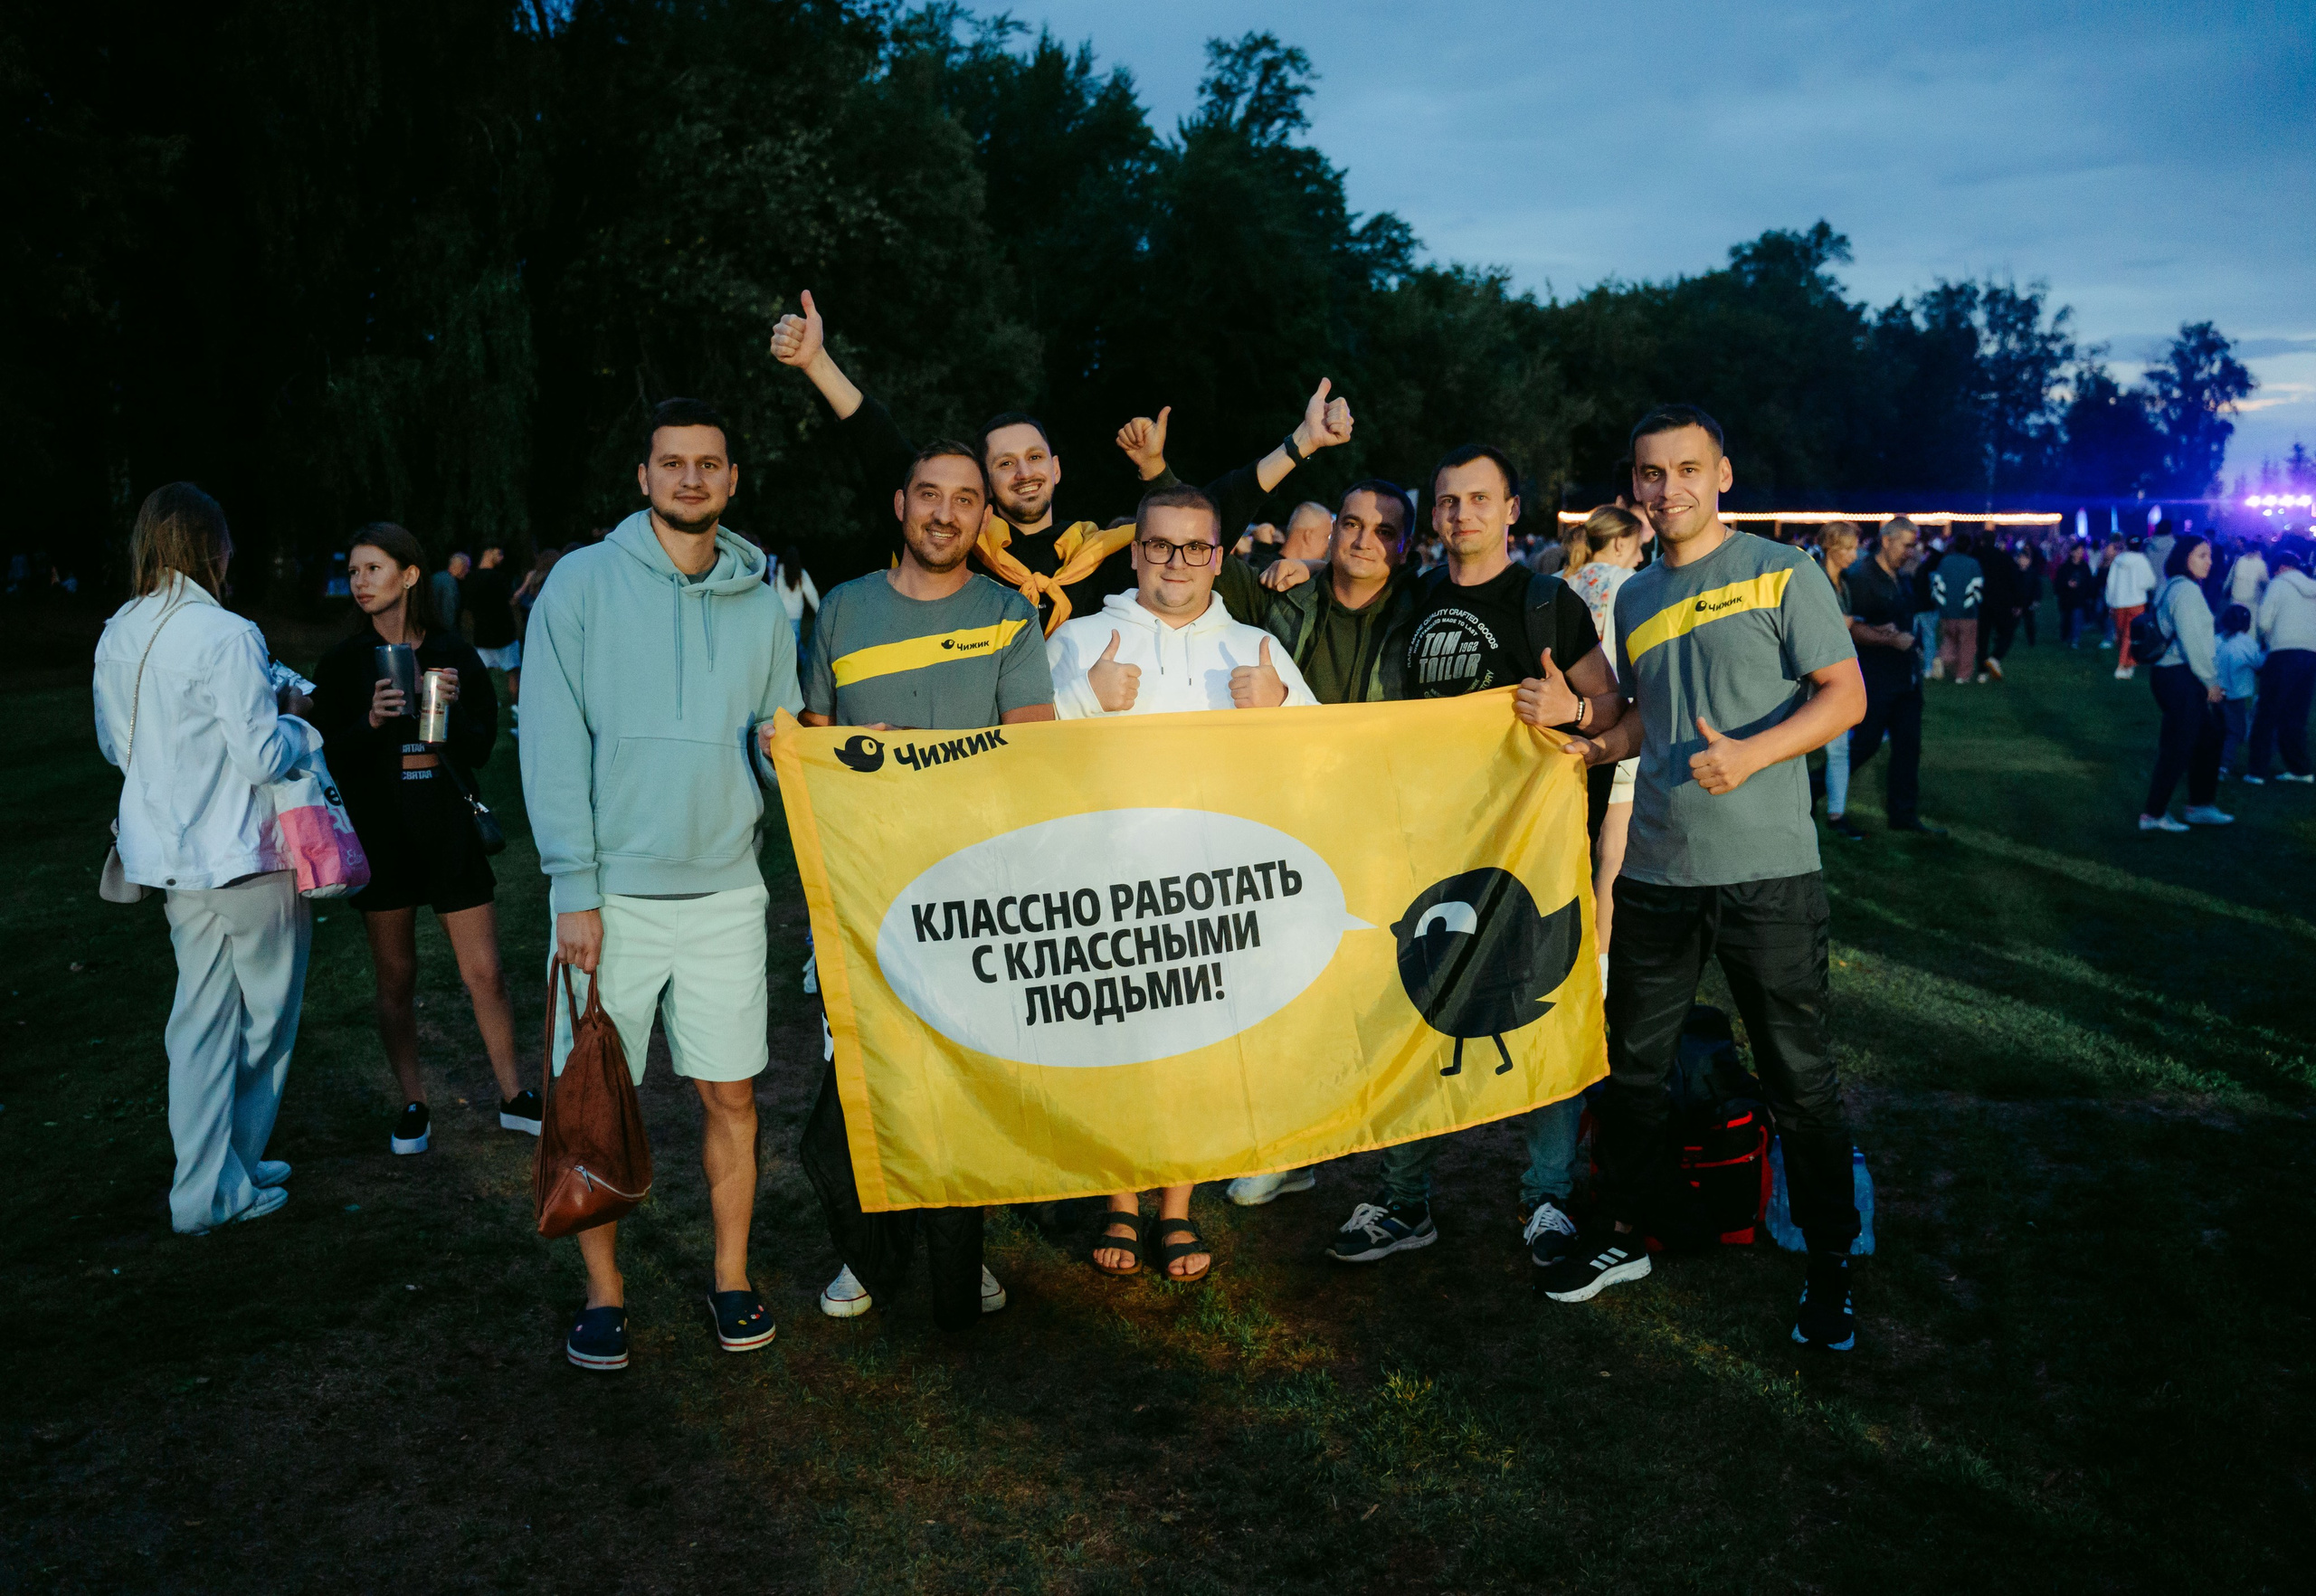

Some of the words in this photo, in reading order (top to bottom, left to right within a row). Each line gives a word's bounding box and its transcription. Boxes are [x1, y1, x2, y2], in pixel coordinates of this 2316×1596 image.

[1708, 595, 1742, 612] Чижик
[956, 640, 990, 651] Чижик
[1421, 631, 1463, 658] TOM
[1458, 641, 1479, 653] 1962
[1423, 608, 1448, 626] QUALITY
[1448, 608, 1479, 625] CRAFTED
[1477, 622, 1499, 650] GOODS
[1465, 623, 1479, 637] LAST
[1419, 653, 1482, 684] TAILOR
[893, 727, 1009, 772] Чижик
[912, 888, 1101, 943] КЛАССНО
[1109, 860, 1303, 923] РАБОТАТЬ
[972, 945, 998, 983] С
[1003, 910, 1261, 981] КЛАССНЫМИ
[1024, 962, 1225, 1026] ЛЮДЬМИ!
